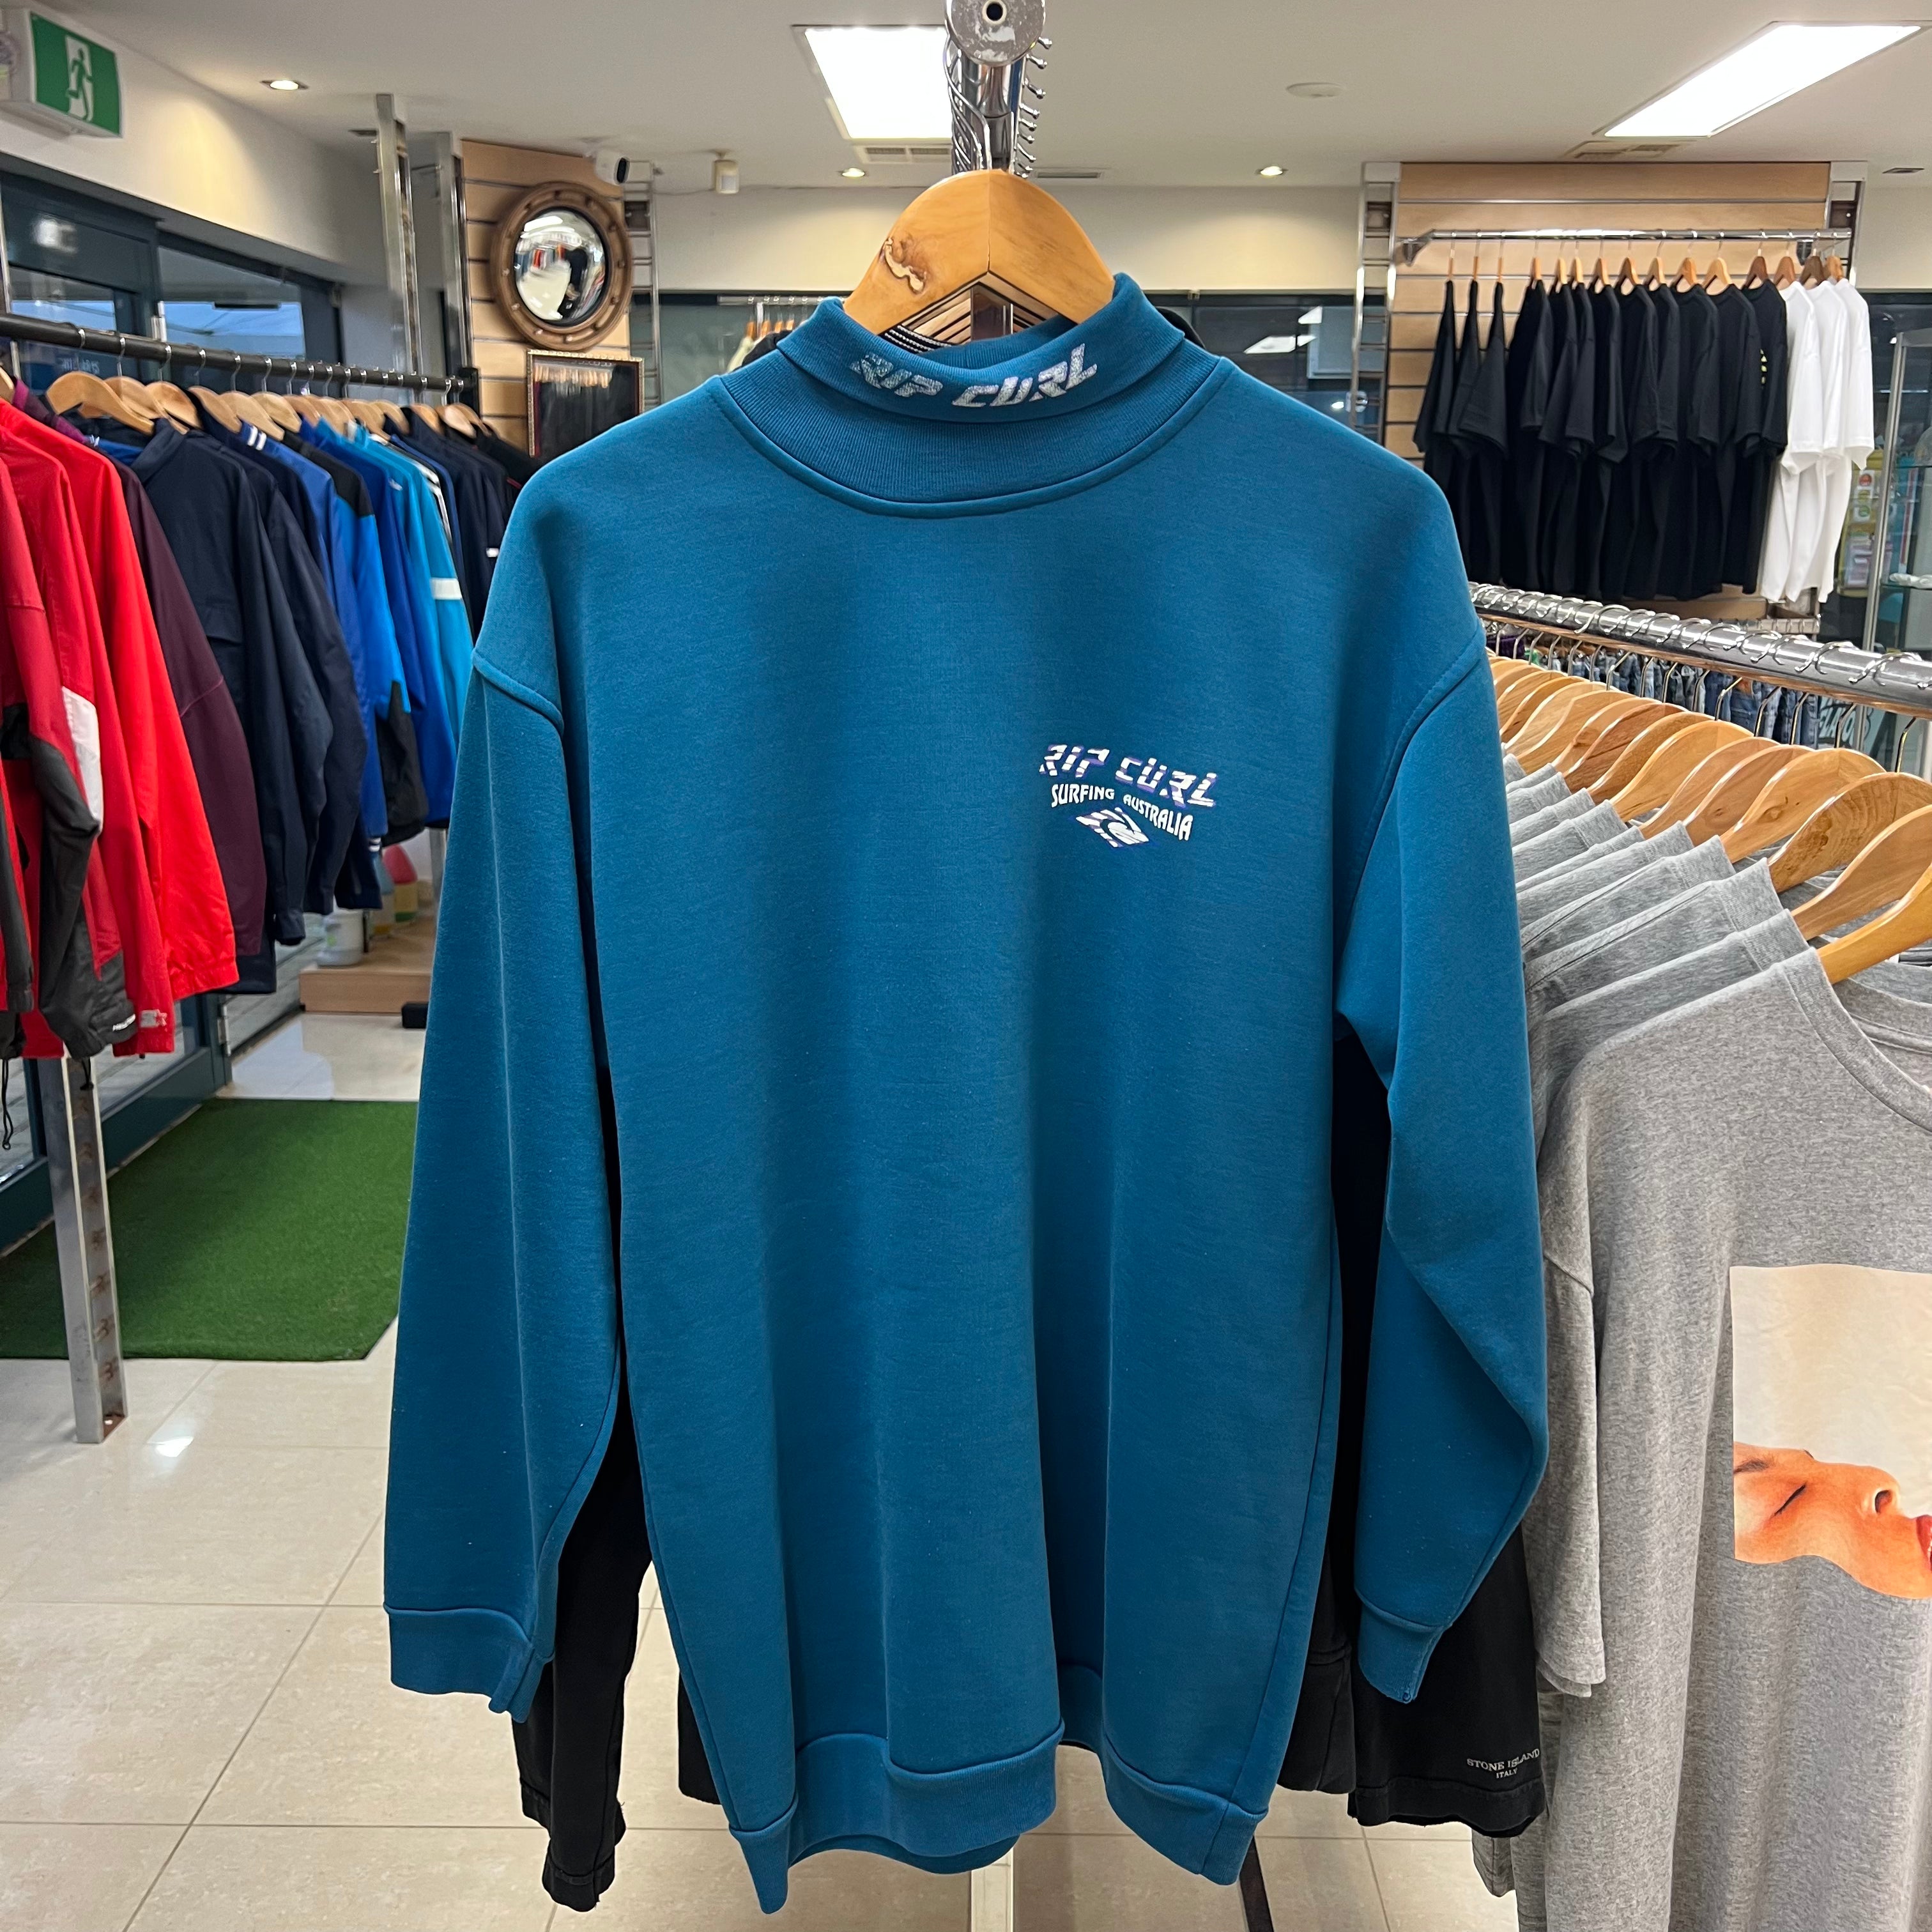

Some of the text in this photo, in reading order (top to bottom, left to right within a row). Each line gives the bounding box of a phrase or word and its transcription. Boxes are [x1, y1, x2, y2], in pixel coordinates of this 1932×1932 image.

[850, 343, 1098, 408] RIP CURL
[1038, 744, 1217, 808] RIP CURL
[1051, 784, 1193, 841] SURFING AUSTRALIA
[1466, 1749, 1540, 1772] STONE ISLAND
[1496, 1768, 1518, 1779] ITALY
